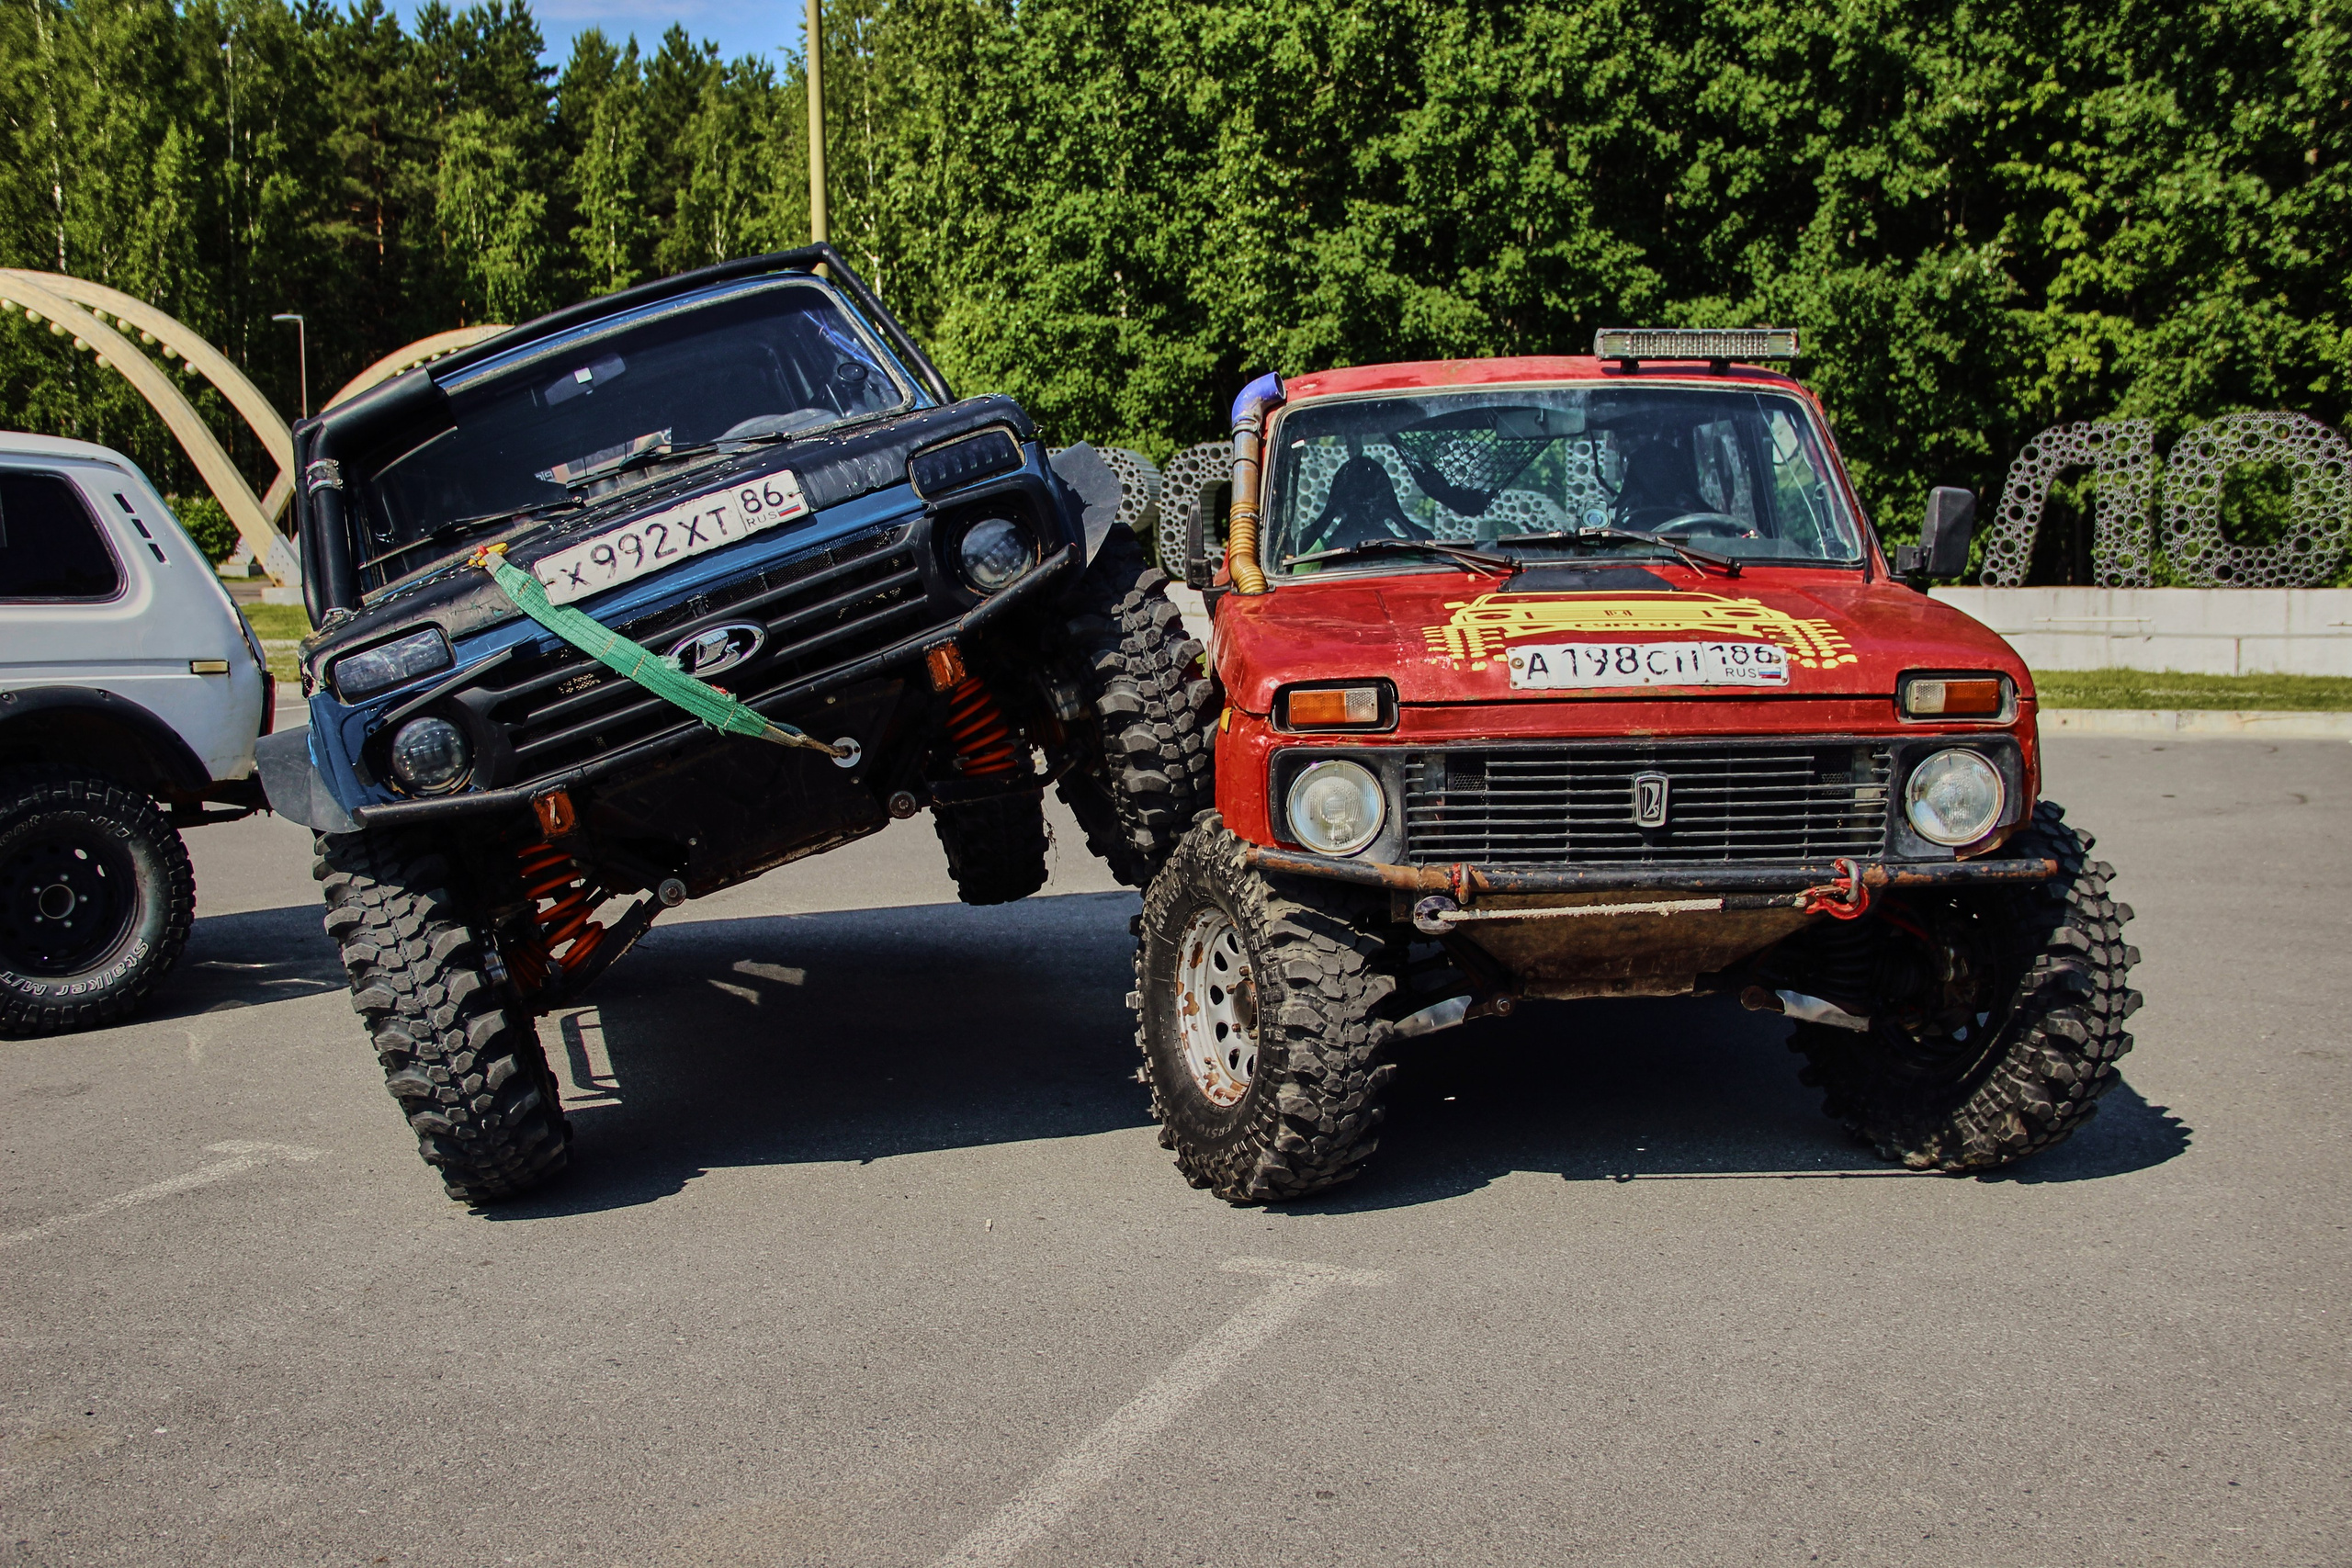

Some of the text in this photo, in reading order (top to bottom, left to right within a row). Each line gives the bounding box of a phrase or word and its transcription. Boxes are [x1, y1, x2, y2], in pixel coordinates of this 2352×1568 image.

[741, 481, 784, 513] 86
[746, 512, 777, 528] RUS
[1709, 645, 1773, 665] 186
[1725, 668, 1757, 678] RUS
[55, 938, 149, 996] Stalker
